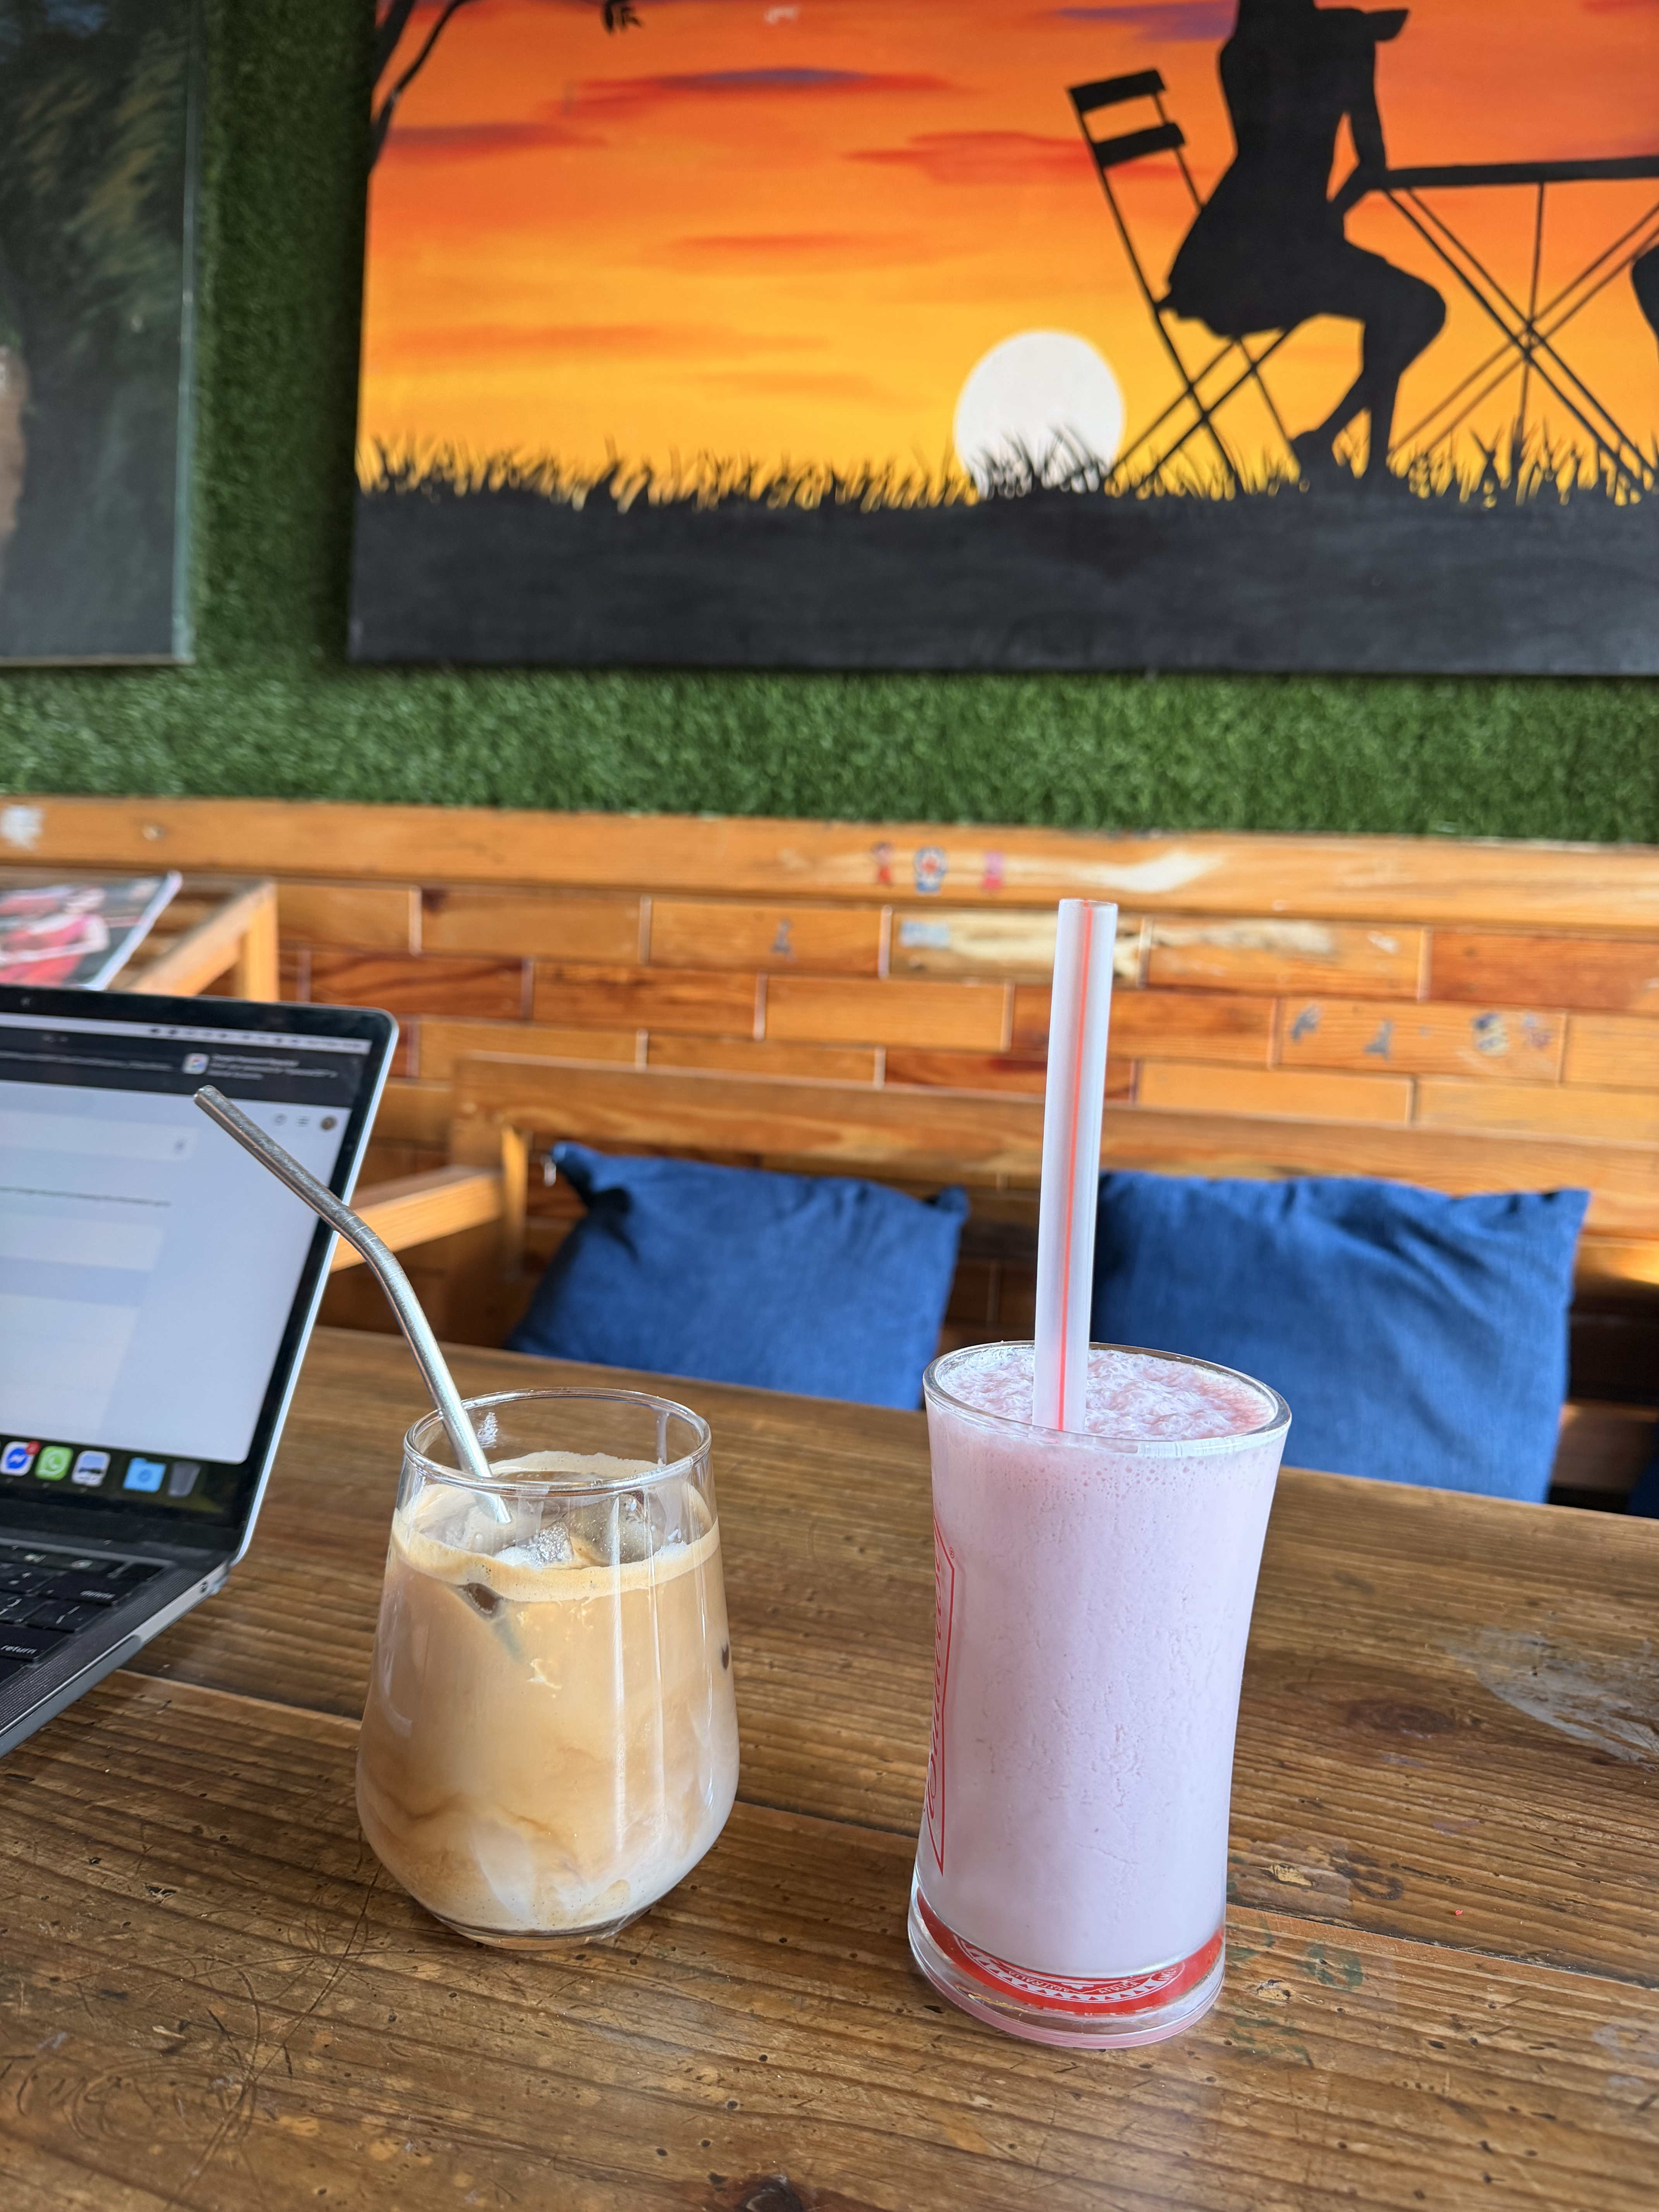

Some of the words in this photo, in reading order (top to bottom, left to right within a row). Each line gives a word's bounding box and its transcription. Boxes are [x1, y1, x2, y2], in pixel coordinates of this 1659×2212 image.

[0, 1645, 38, 1654] return
[1008, 1970, 1070, 1992] AUSTRALIA
[1098, 1981, 1141, 1994] AFRICA
